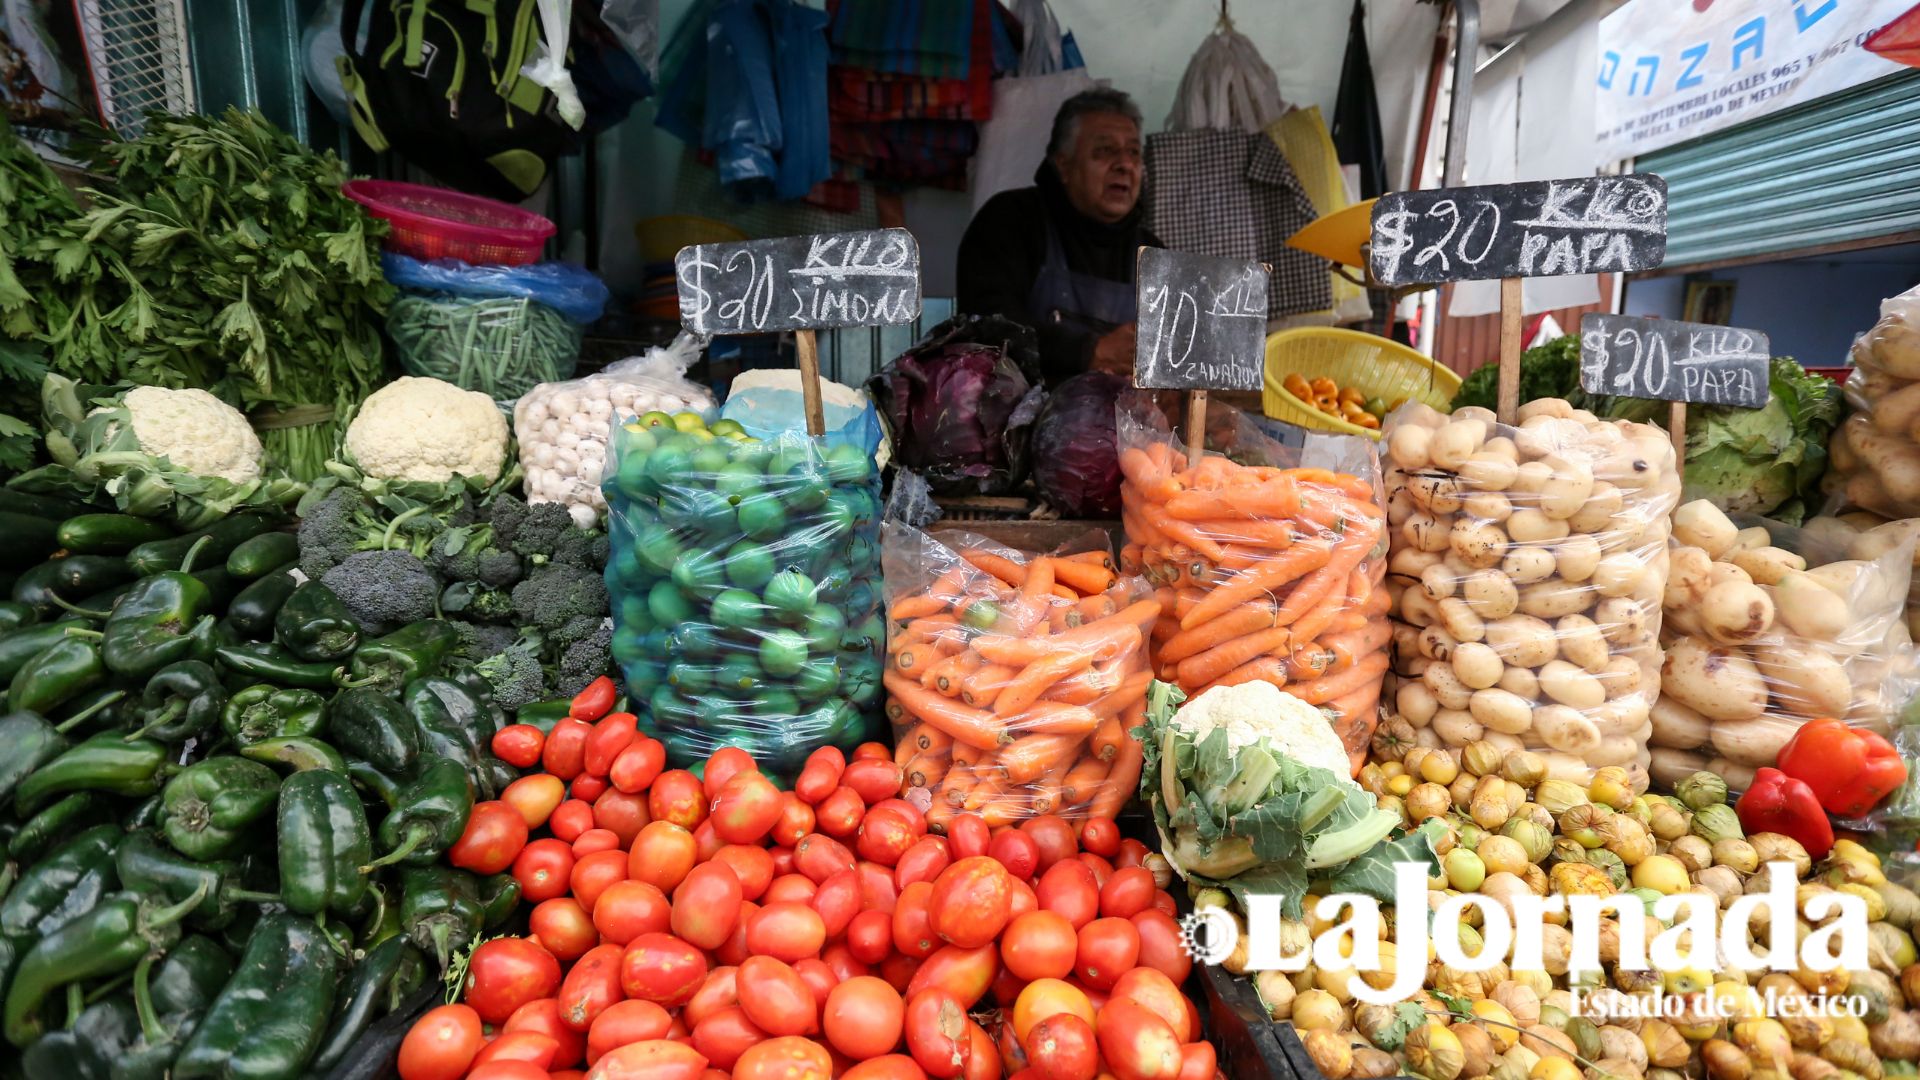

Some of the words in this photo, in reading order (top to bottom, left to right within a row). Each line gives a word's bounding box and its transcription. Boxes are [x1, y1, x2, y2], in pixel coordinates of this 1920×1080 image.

[1712, 71, 1766, 101] LOCALES
[1771, 59, 1800, 81] 965
[1807, 53, 1816, 68] Y
[1678, 104, 1724, 128] ESTADO
[1728, 96, 1744, 113] DE
[1373, 197, 1501, 284] $20
[1538, 178, 1664, 222] KILO
[1518, 231, 1634, 276] PAPA
[680, 244, 774, 333] $20
[805, 233, 909, 269] KILO
[1148, 284, 1198, 380] 10
[1582, 318, 1669, 396] $20
[1689, 331, 1753, 357] KILO
[1683, 366, 1757, 403] PAPA
